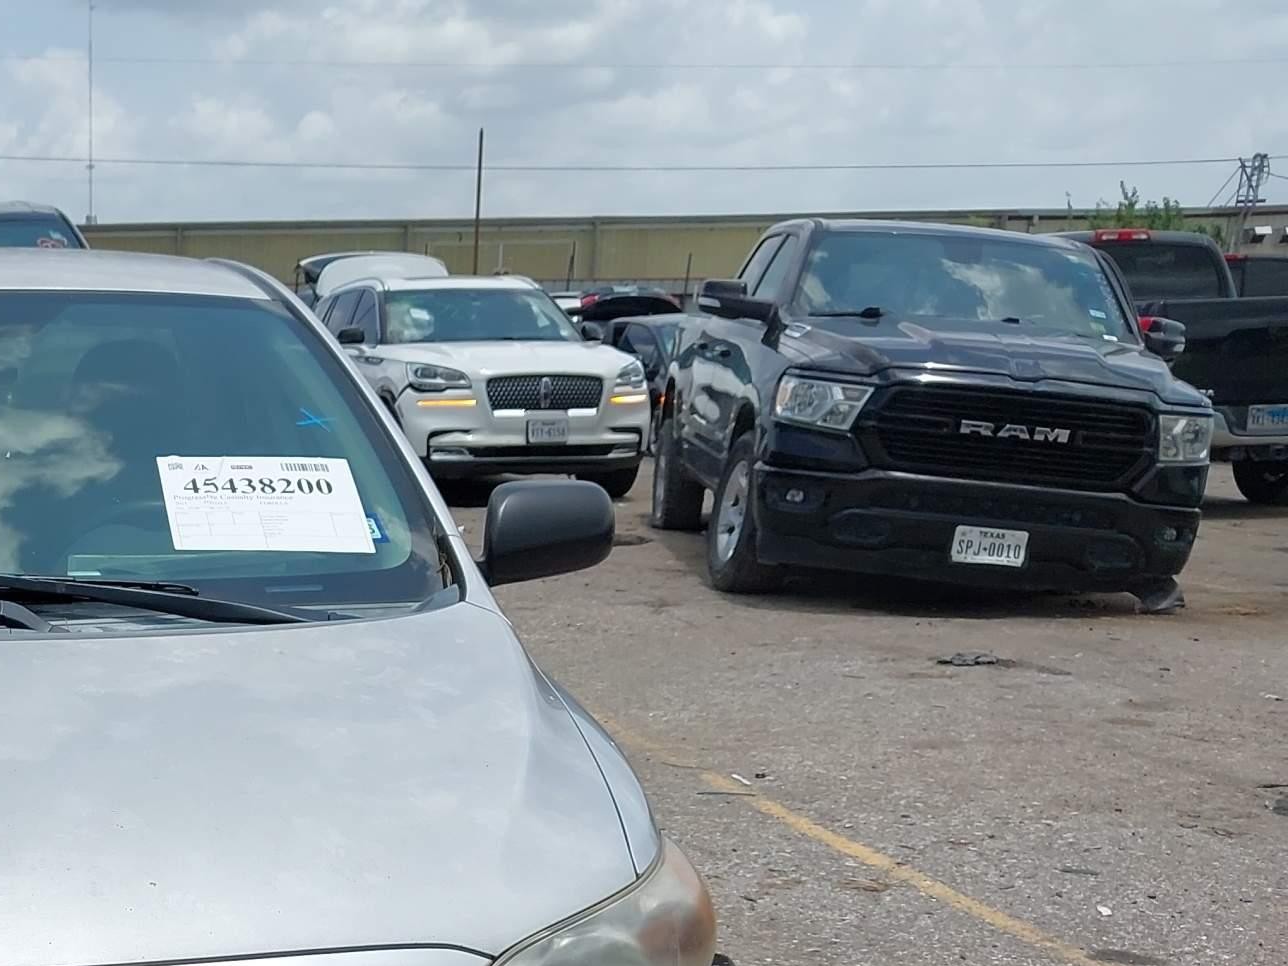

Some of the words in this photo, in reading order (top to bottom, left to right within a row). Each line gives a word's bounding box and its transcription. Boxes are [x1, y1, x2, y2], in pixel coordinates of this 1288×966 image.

[960, 419, 1071, 443] RAM
[183, 476, 333, 495] 45438200
[979, 530, 1006, 540] TEXAS
